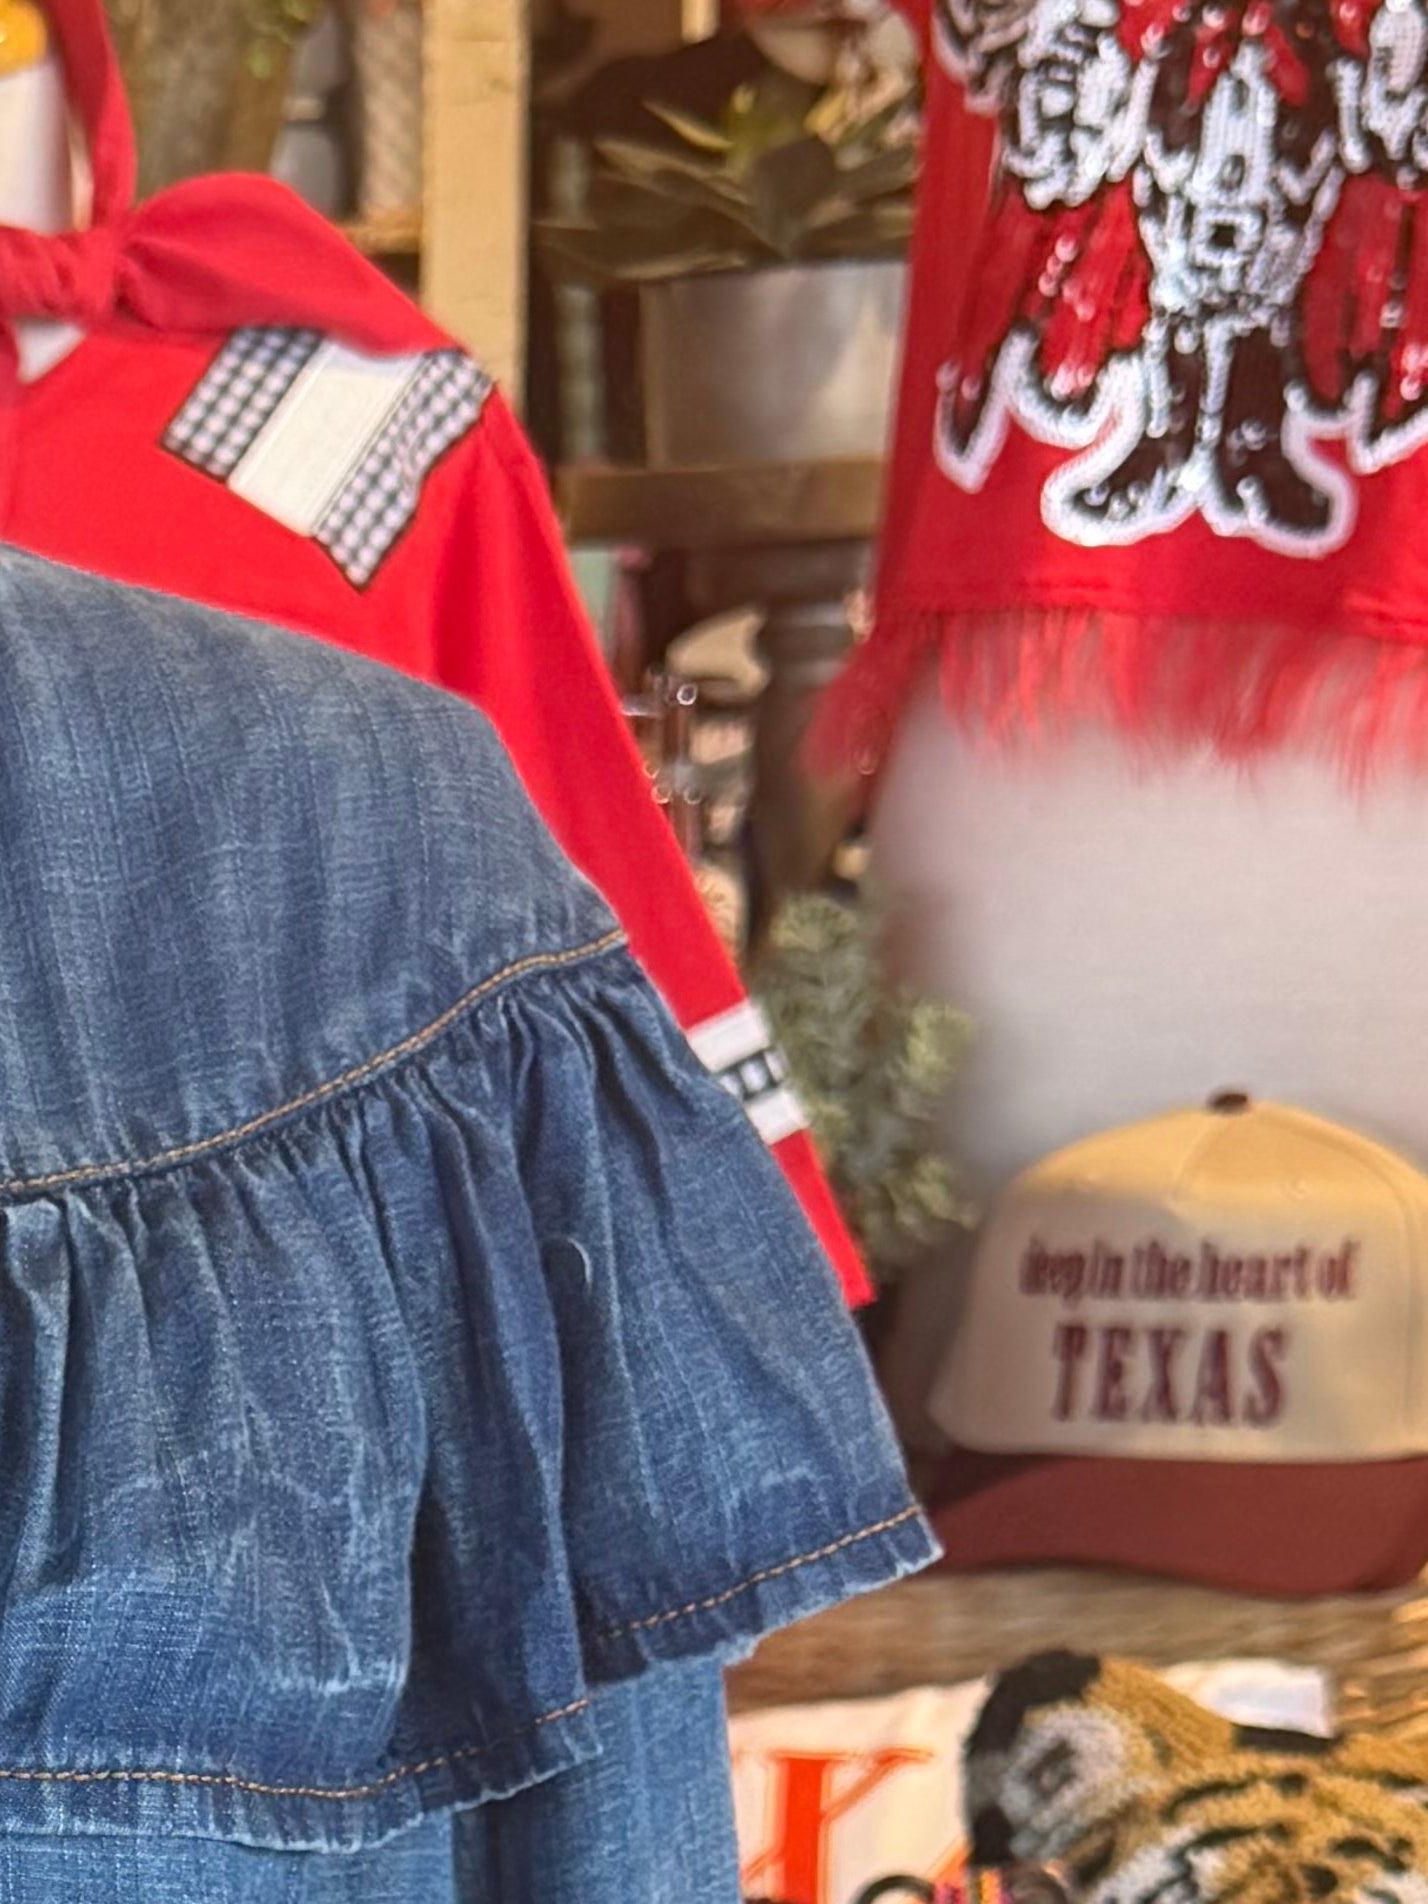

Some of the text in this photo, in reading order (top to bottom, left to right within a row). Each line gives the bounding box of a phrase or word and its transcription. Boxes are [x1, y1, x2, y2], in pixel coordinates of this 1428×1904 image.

[1088, 1239, 1124, 1299] in
[1130, 1240, 1190, 1300] the
[1197, 1240, 1309, 1302] heart
[1318, 1239, 1362, 1302] of
[1051, 1321, 1290, 1427] TEXAS
